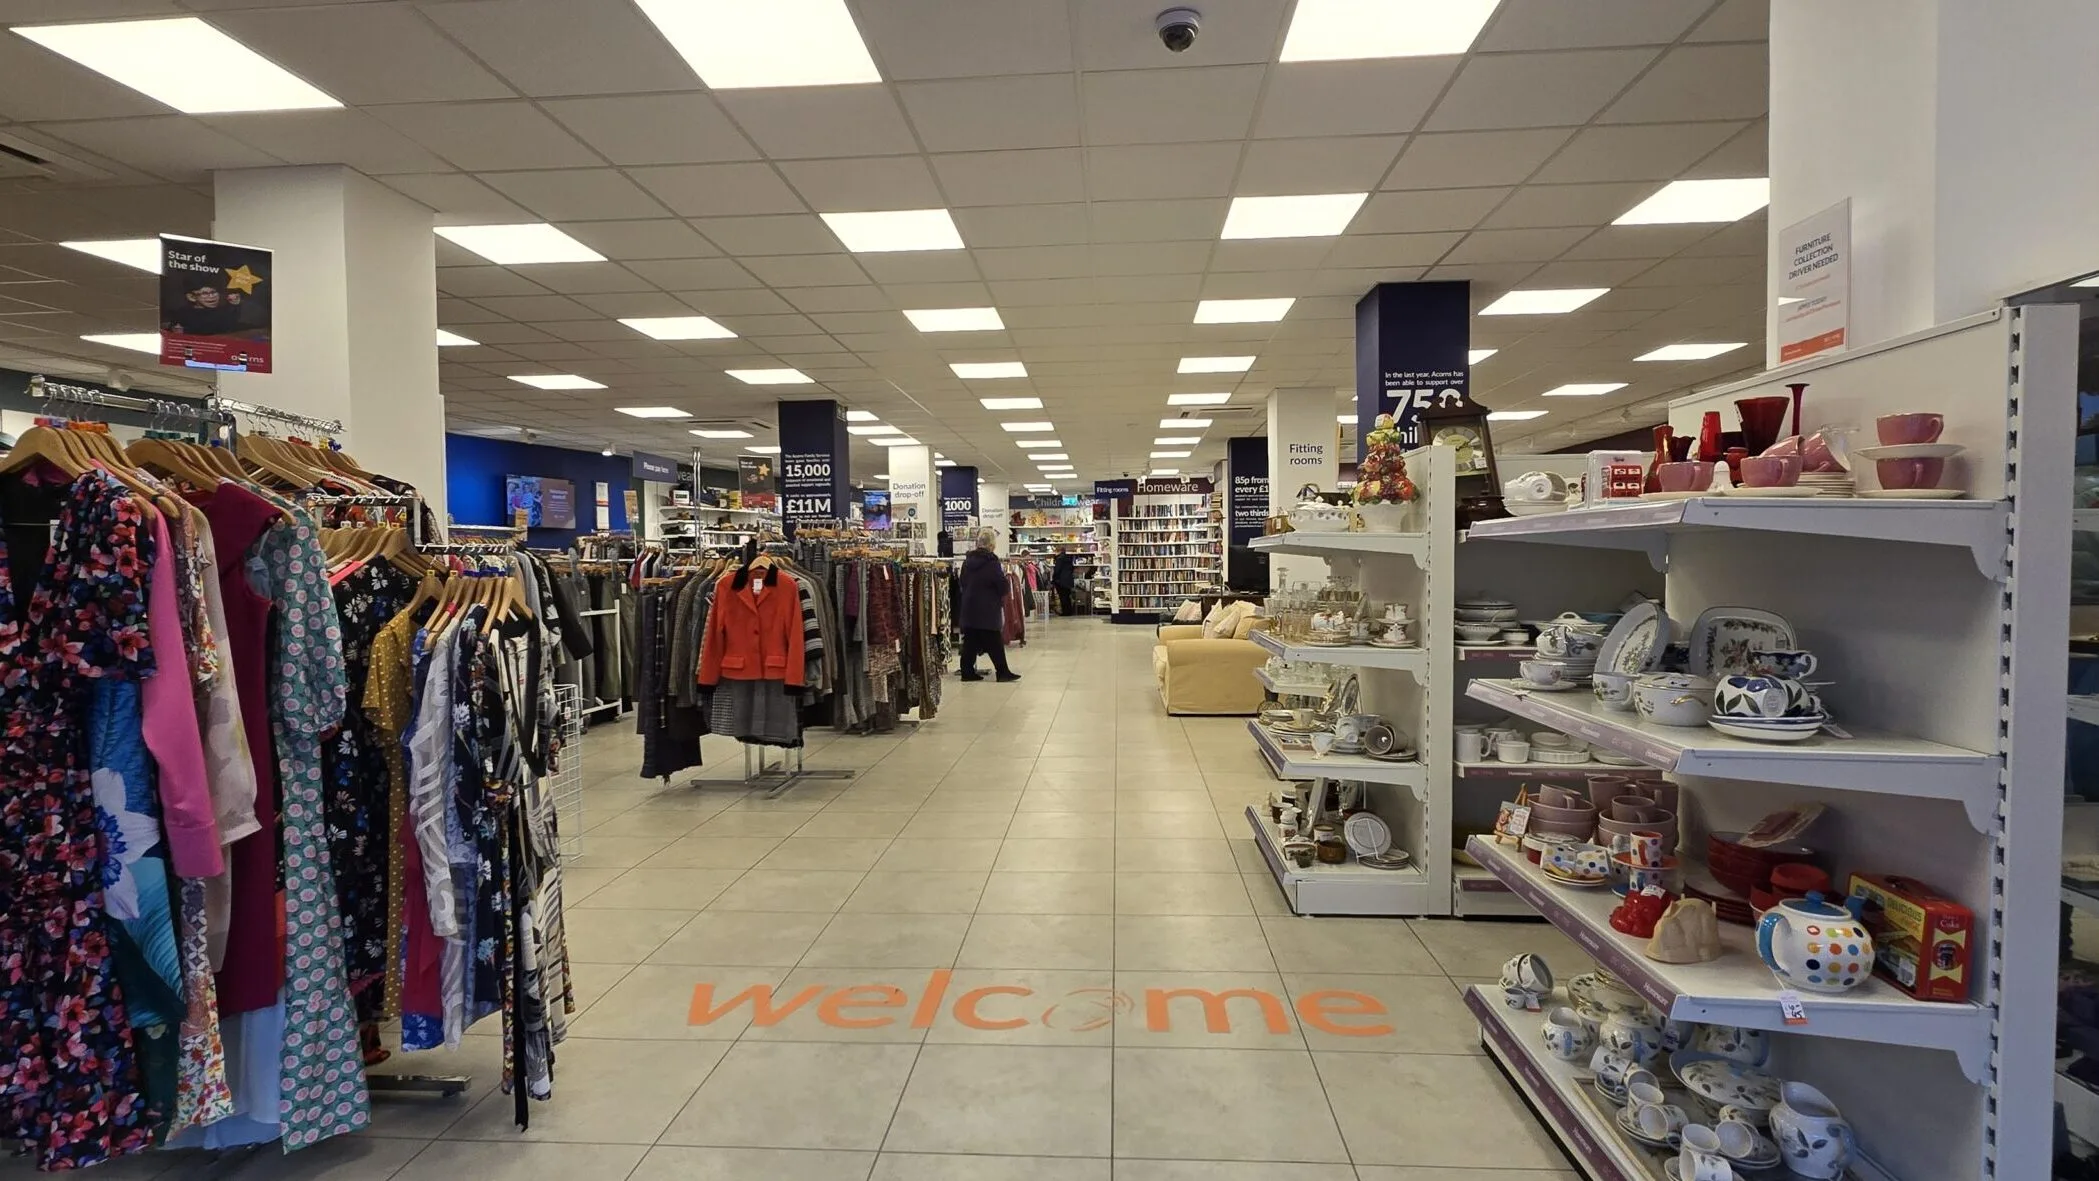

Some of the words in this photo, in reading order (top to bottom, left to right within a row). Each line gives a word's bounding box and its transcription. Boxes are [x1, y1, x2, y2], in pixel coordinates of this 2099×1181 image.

[1795, 232, 1831, 255] FURNITURE
[168, 250, 192, 261] Star
[194, 255, 207, 263] of
[1793, 244, 1833, 266] COLLECTION
[168, 260, 187, 270] the
[189, 262, 220, 274] show
[1788, 263, 1812, 280] DRIVER
[1812, 253, 1839, 271] NEEDED
[231, 354, 265, 363] arns
[1289, 443, 1324, 455] Fitting
[1289, 457, 1323, 465] rooms
[785, 463, 831, 478] 15,000
[892, 482, 926, 490] Donation
[1234, 476, 1250, 485] 85p
[1096, 486, 1113, 495] Fitting
[1137, 482, 1199, 493] Homeware
[1234, 486, 1258, 495] every
[894, 490, 925, 499] drop-off
[785, 498, 831, 514] £11M
[944, 500, 972, 511] 1000
